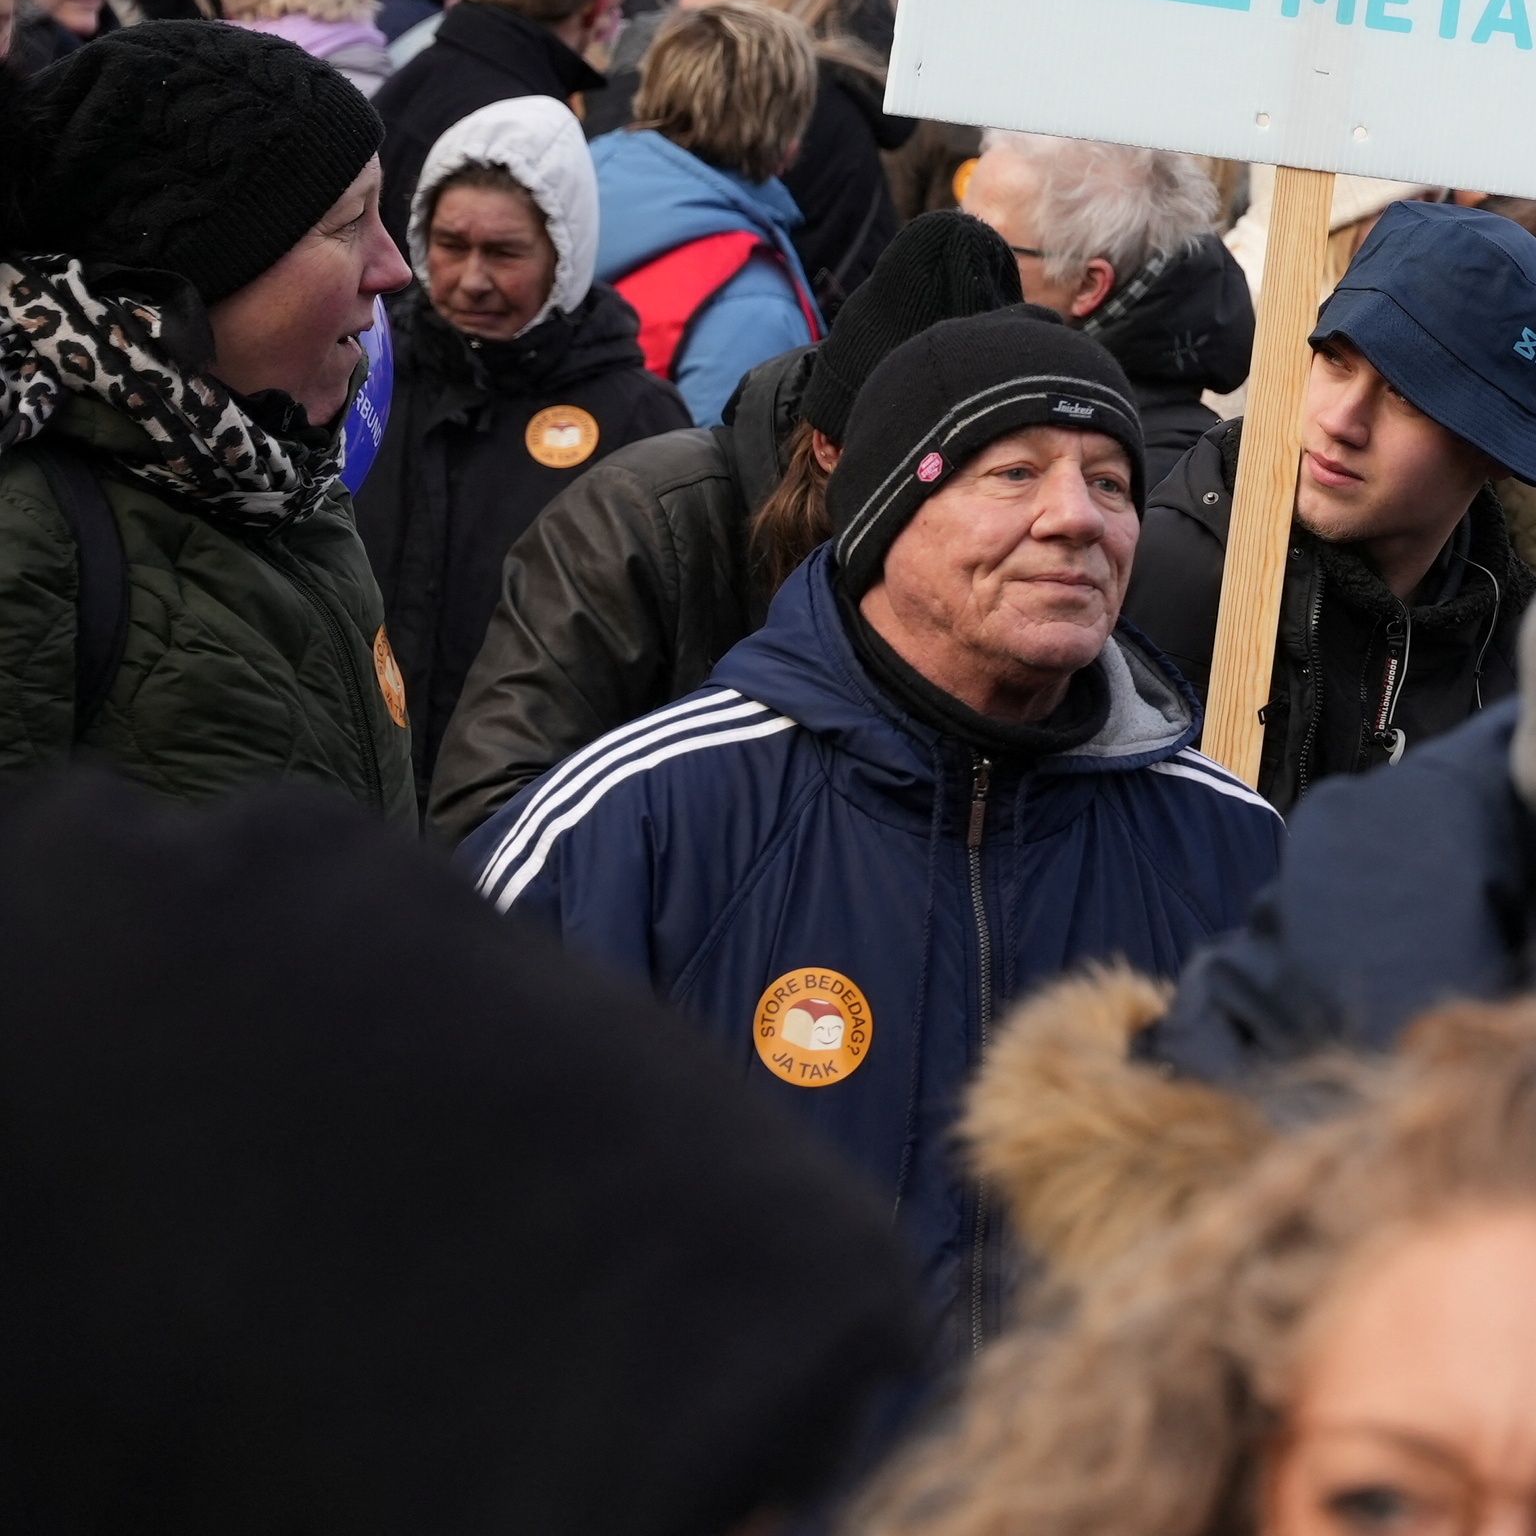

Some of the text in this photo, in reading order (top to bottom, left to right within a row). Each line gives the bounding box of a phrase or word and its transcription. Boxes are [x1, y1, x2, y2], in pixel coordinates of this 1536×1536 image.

[353, 389, 382, 448] RBUND
[1052, 400, 1096, 417] Snickers
[761, 974, 866, 1056] STORE BEDEDAG?
[772, 1052, 838, 1079] JA TAK
